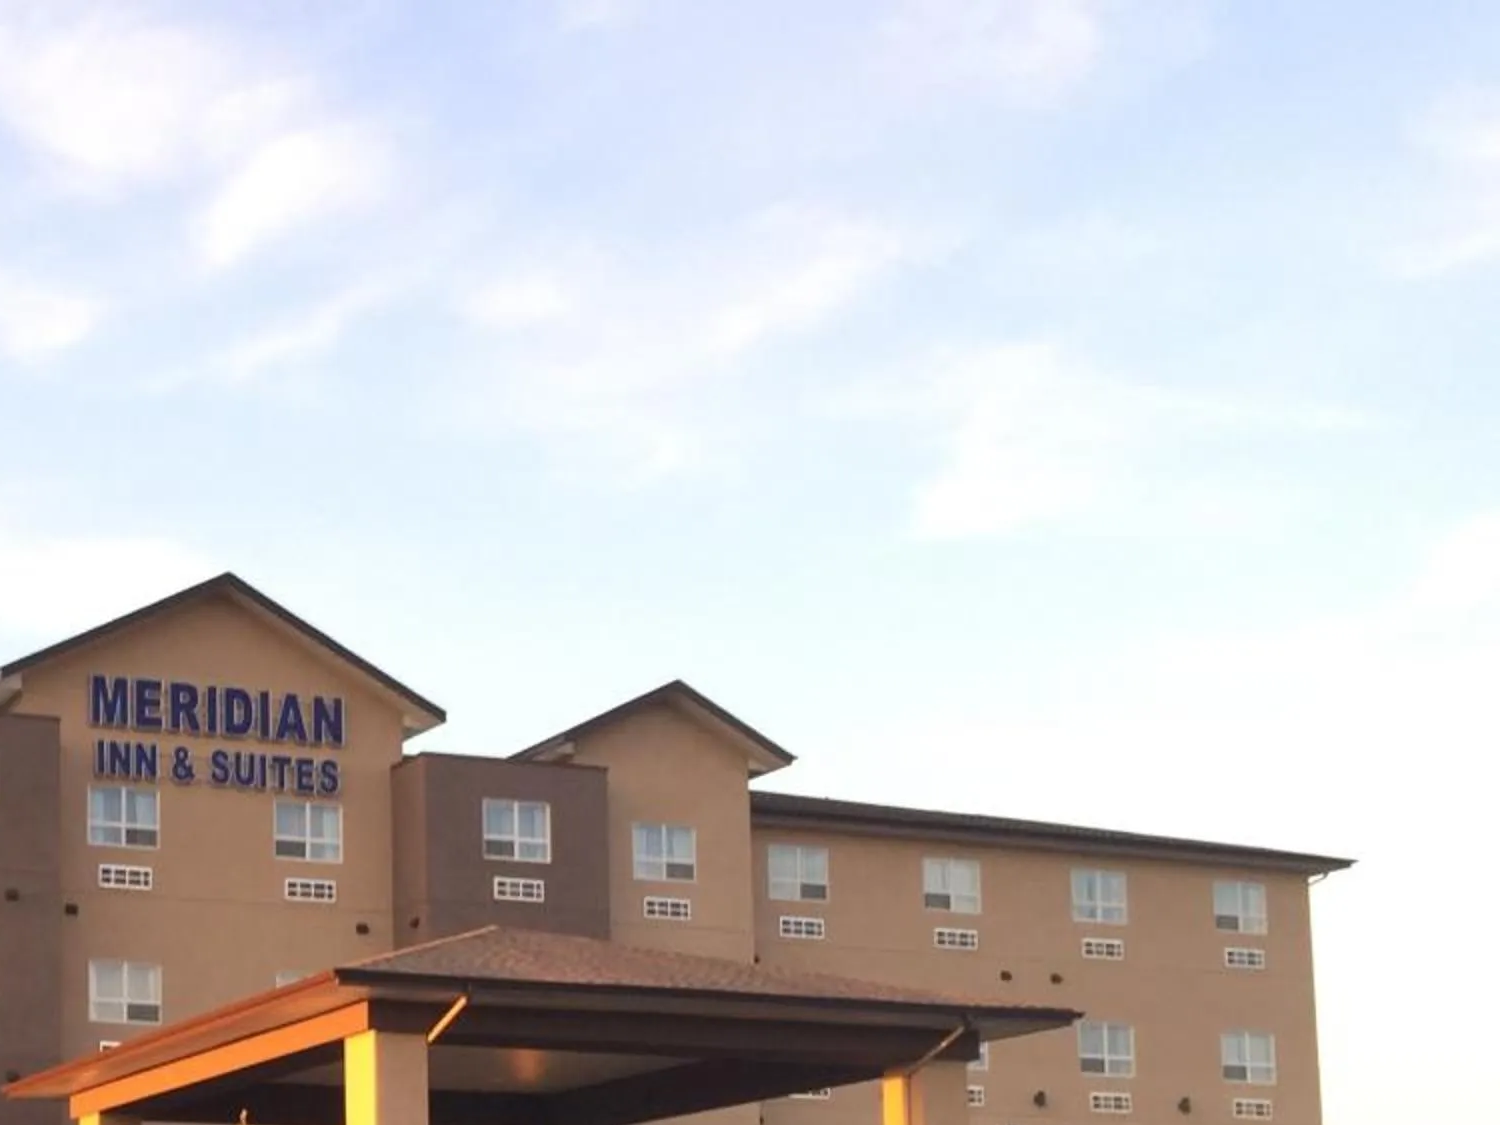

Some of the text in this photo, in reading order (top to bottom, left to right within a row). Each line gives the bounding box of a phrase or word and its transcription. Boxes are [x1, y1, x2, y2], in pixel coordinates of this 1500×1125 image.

[90, 674, 343, 745] MERIDIAN
[96, 739, 339, 794] INN & SUITES
